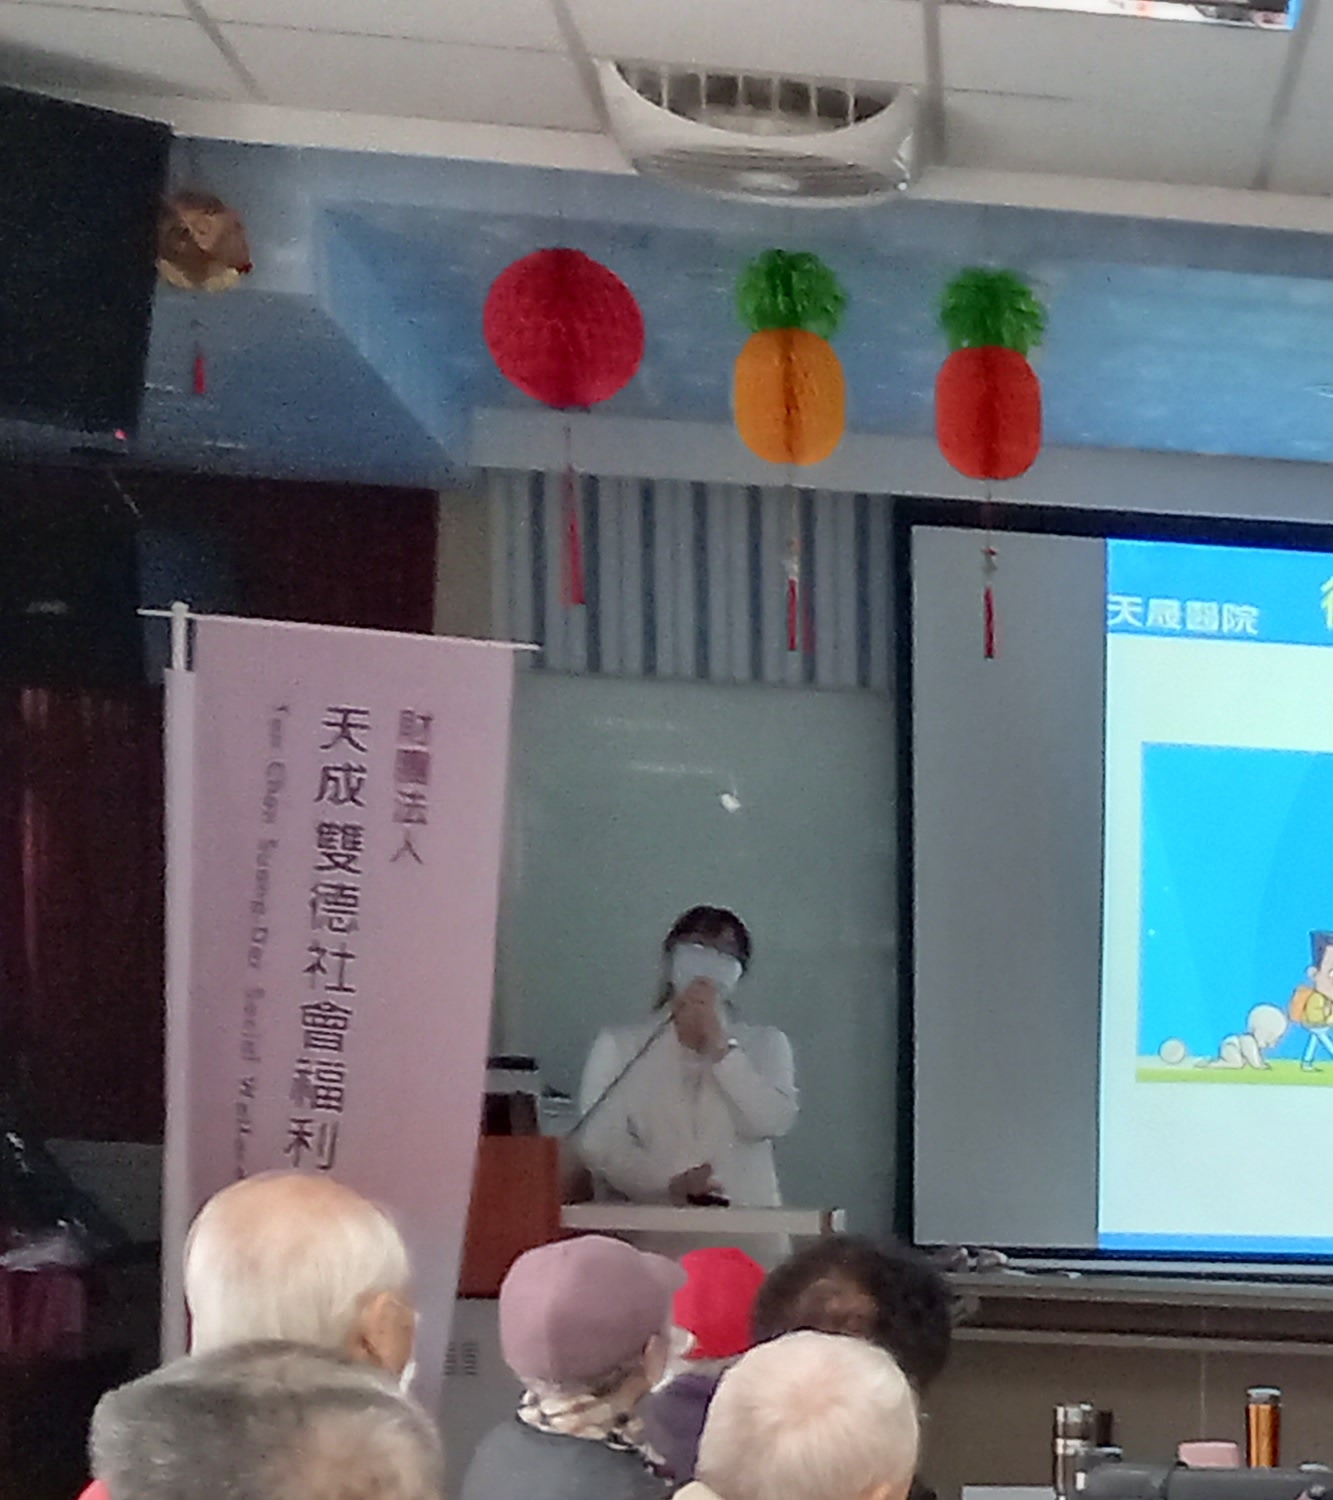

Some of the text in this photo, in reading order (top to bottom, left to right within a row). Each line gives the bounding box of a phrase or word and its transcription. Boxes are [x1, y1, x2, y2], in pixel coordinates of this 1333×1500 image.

[284, 705, 371, 1171] 天成雙德社會福利
